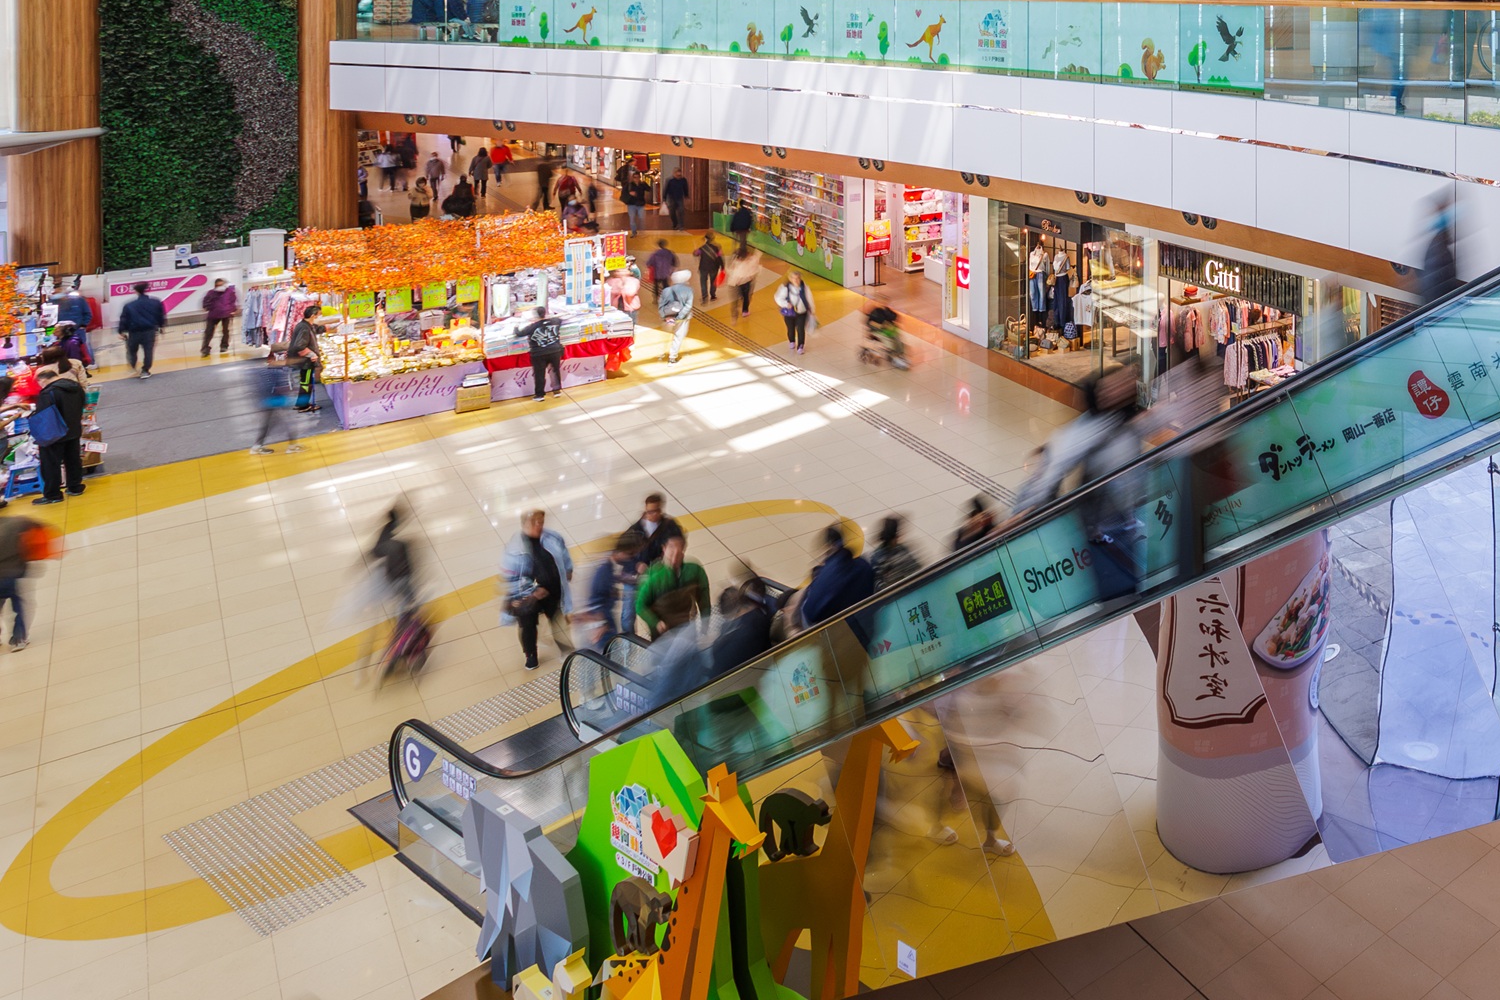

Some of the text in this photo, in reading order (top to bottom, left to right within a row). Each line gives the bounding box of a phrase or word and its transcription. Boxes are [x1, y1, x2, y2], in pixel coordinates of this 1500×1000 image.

[1205, 260, 1240, 293] Gitti
[371, 374, 445, 394] Happy
[1411, 378, 1442, 412] 譚仔
[1342, 408, 1396, 442] 岡山一番店
[1023, 547, 1093, 593] Sharete
[1196, 593, 1230, 700] 六和冰室
[406, 743, 421, 777] G
